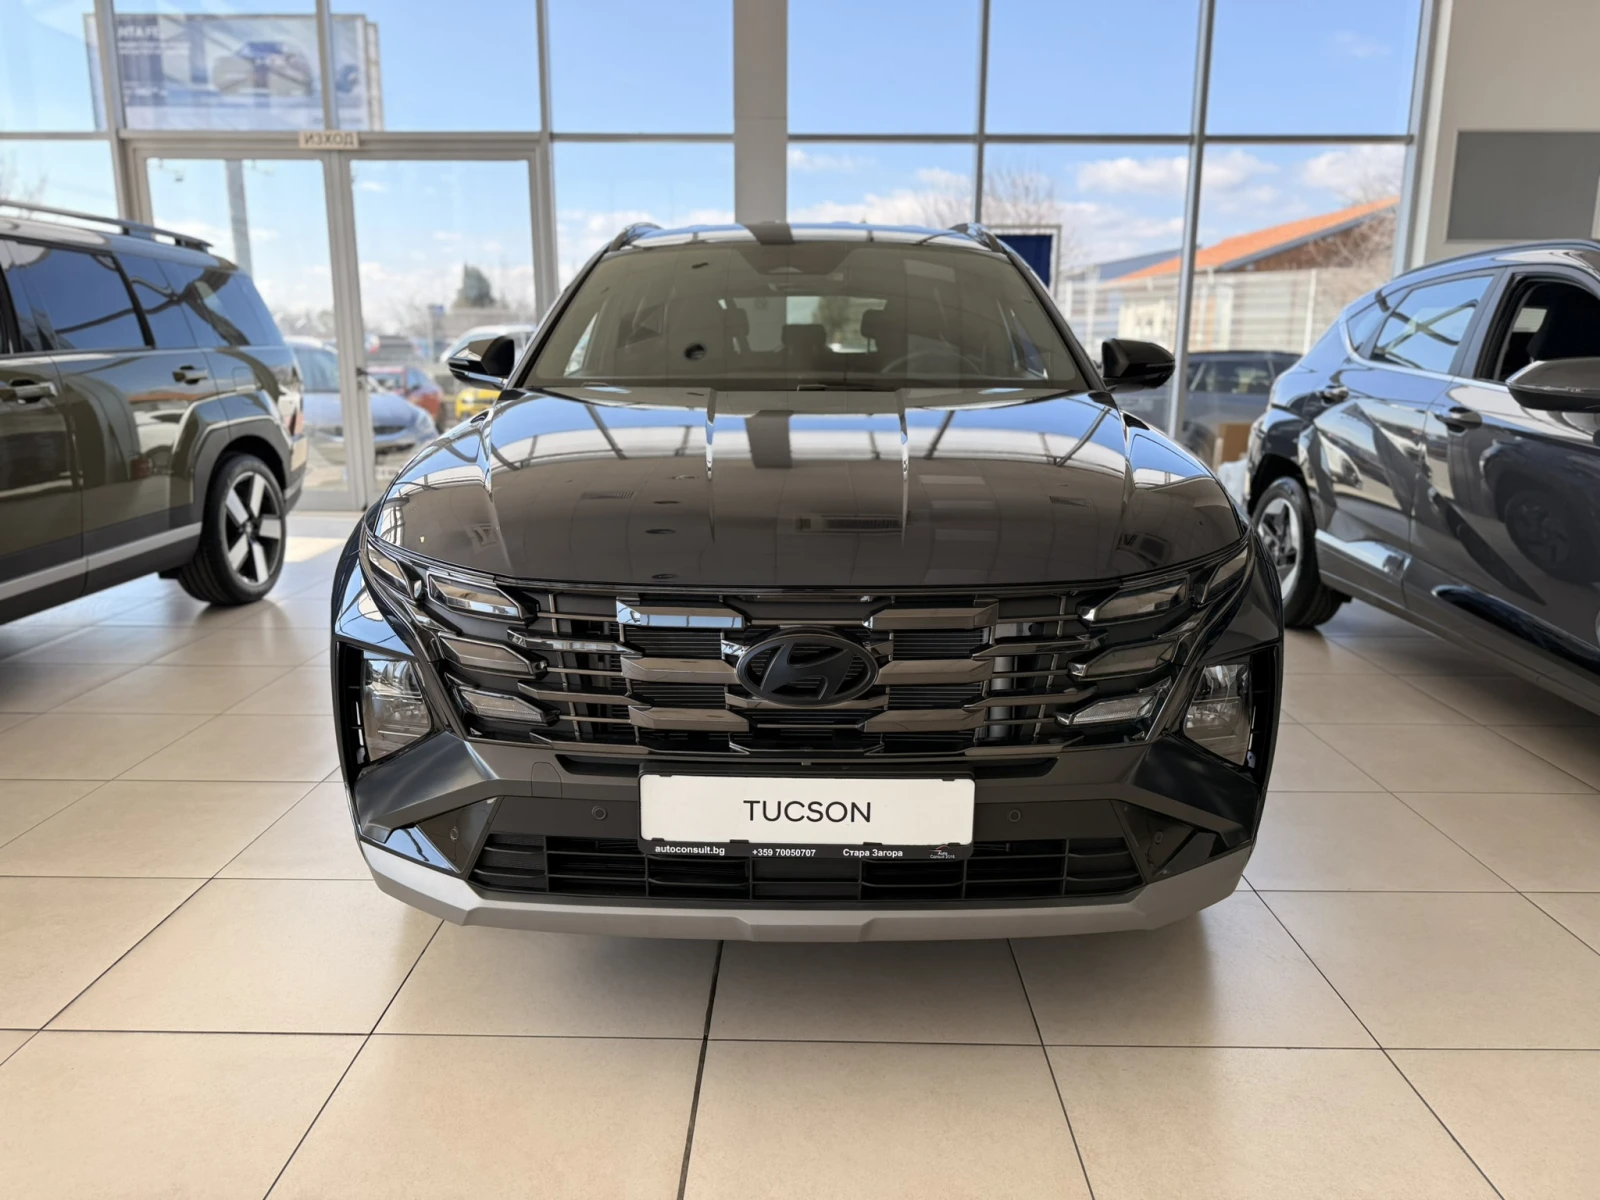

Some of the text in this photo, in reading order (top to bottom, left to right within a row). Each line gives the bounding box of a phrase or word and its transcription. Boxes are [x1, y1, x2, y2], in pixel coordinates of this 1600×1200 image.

[743, 800, 871, 822] TUCSON
[655, 845, 725, 856] autoconsult.bg
[752, 848, 816, 857] +359 70050707
[842, 848, 903, 858] Стара Загора
